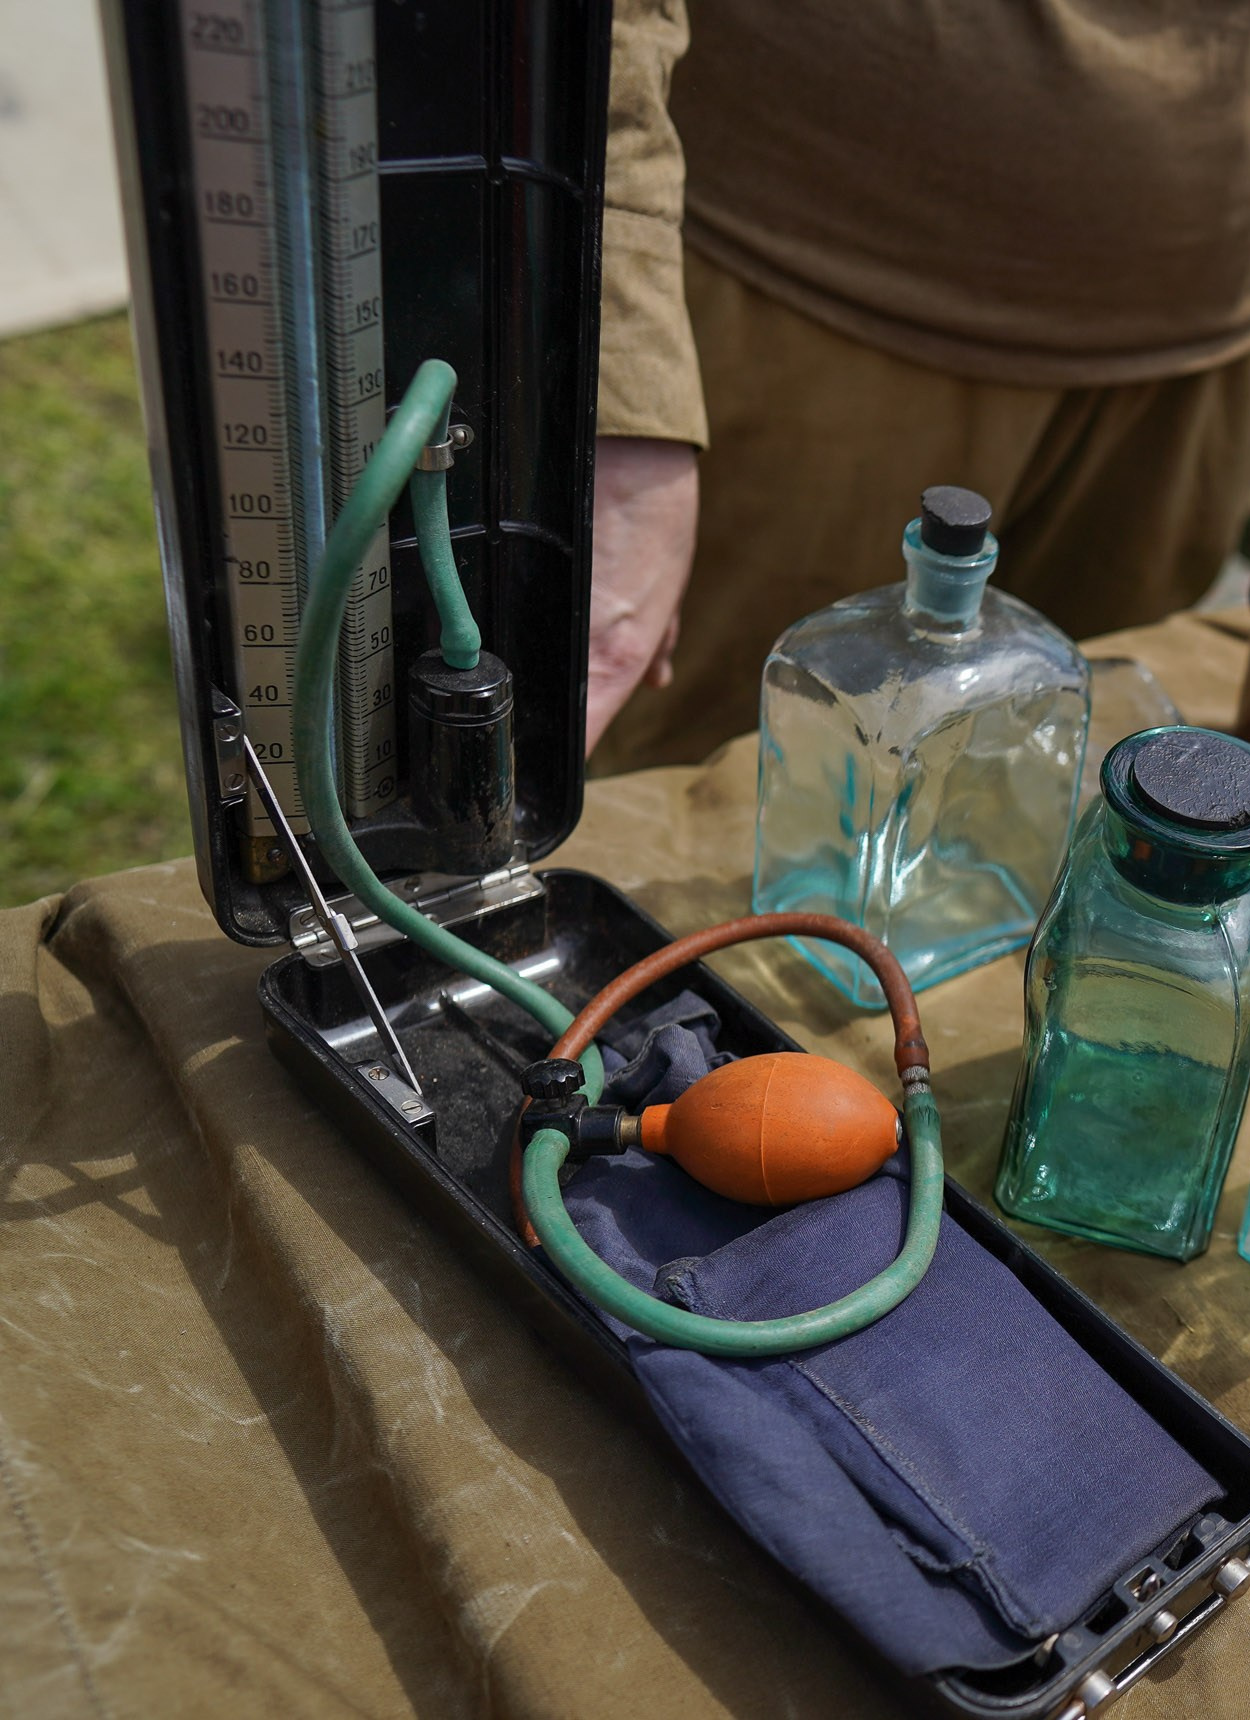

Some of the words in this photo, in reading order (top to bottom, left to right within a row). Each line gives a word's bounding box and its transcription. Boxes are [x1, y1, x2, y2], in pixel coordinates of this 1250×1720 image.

[198, 102, 249, 133] 200
[205, 190, 253, 218] 180
[212, 271, 258, 297] 160
[218, 350, 262, 373] 140
[224, 423, 267, 445] 120
[230, 493, 271, 513] 100
[240, 561, 270, 579] 80
[369, 566, 387, 590] 70
[244, 624, 274, 642] 60
[371, 626, 389, 650] 50
[249, 685, 278, 701] 40
[373, 683, 391, 707] 30
[254, 743, 283, 759] 20
[376, 740, 392, 761] 10
